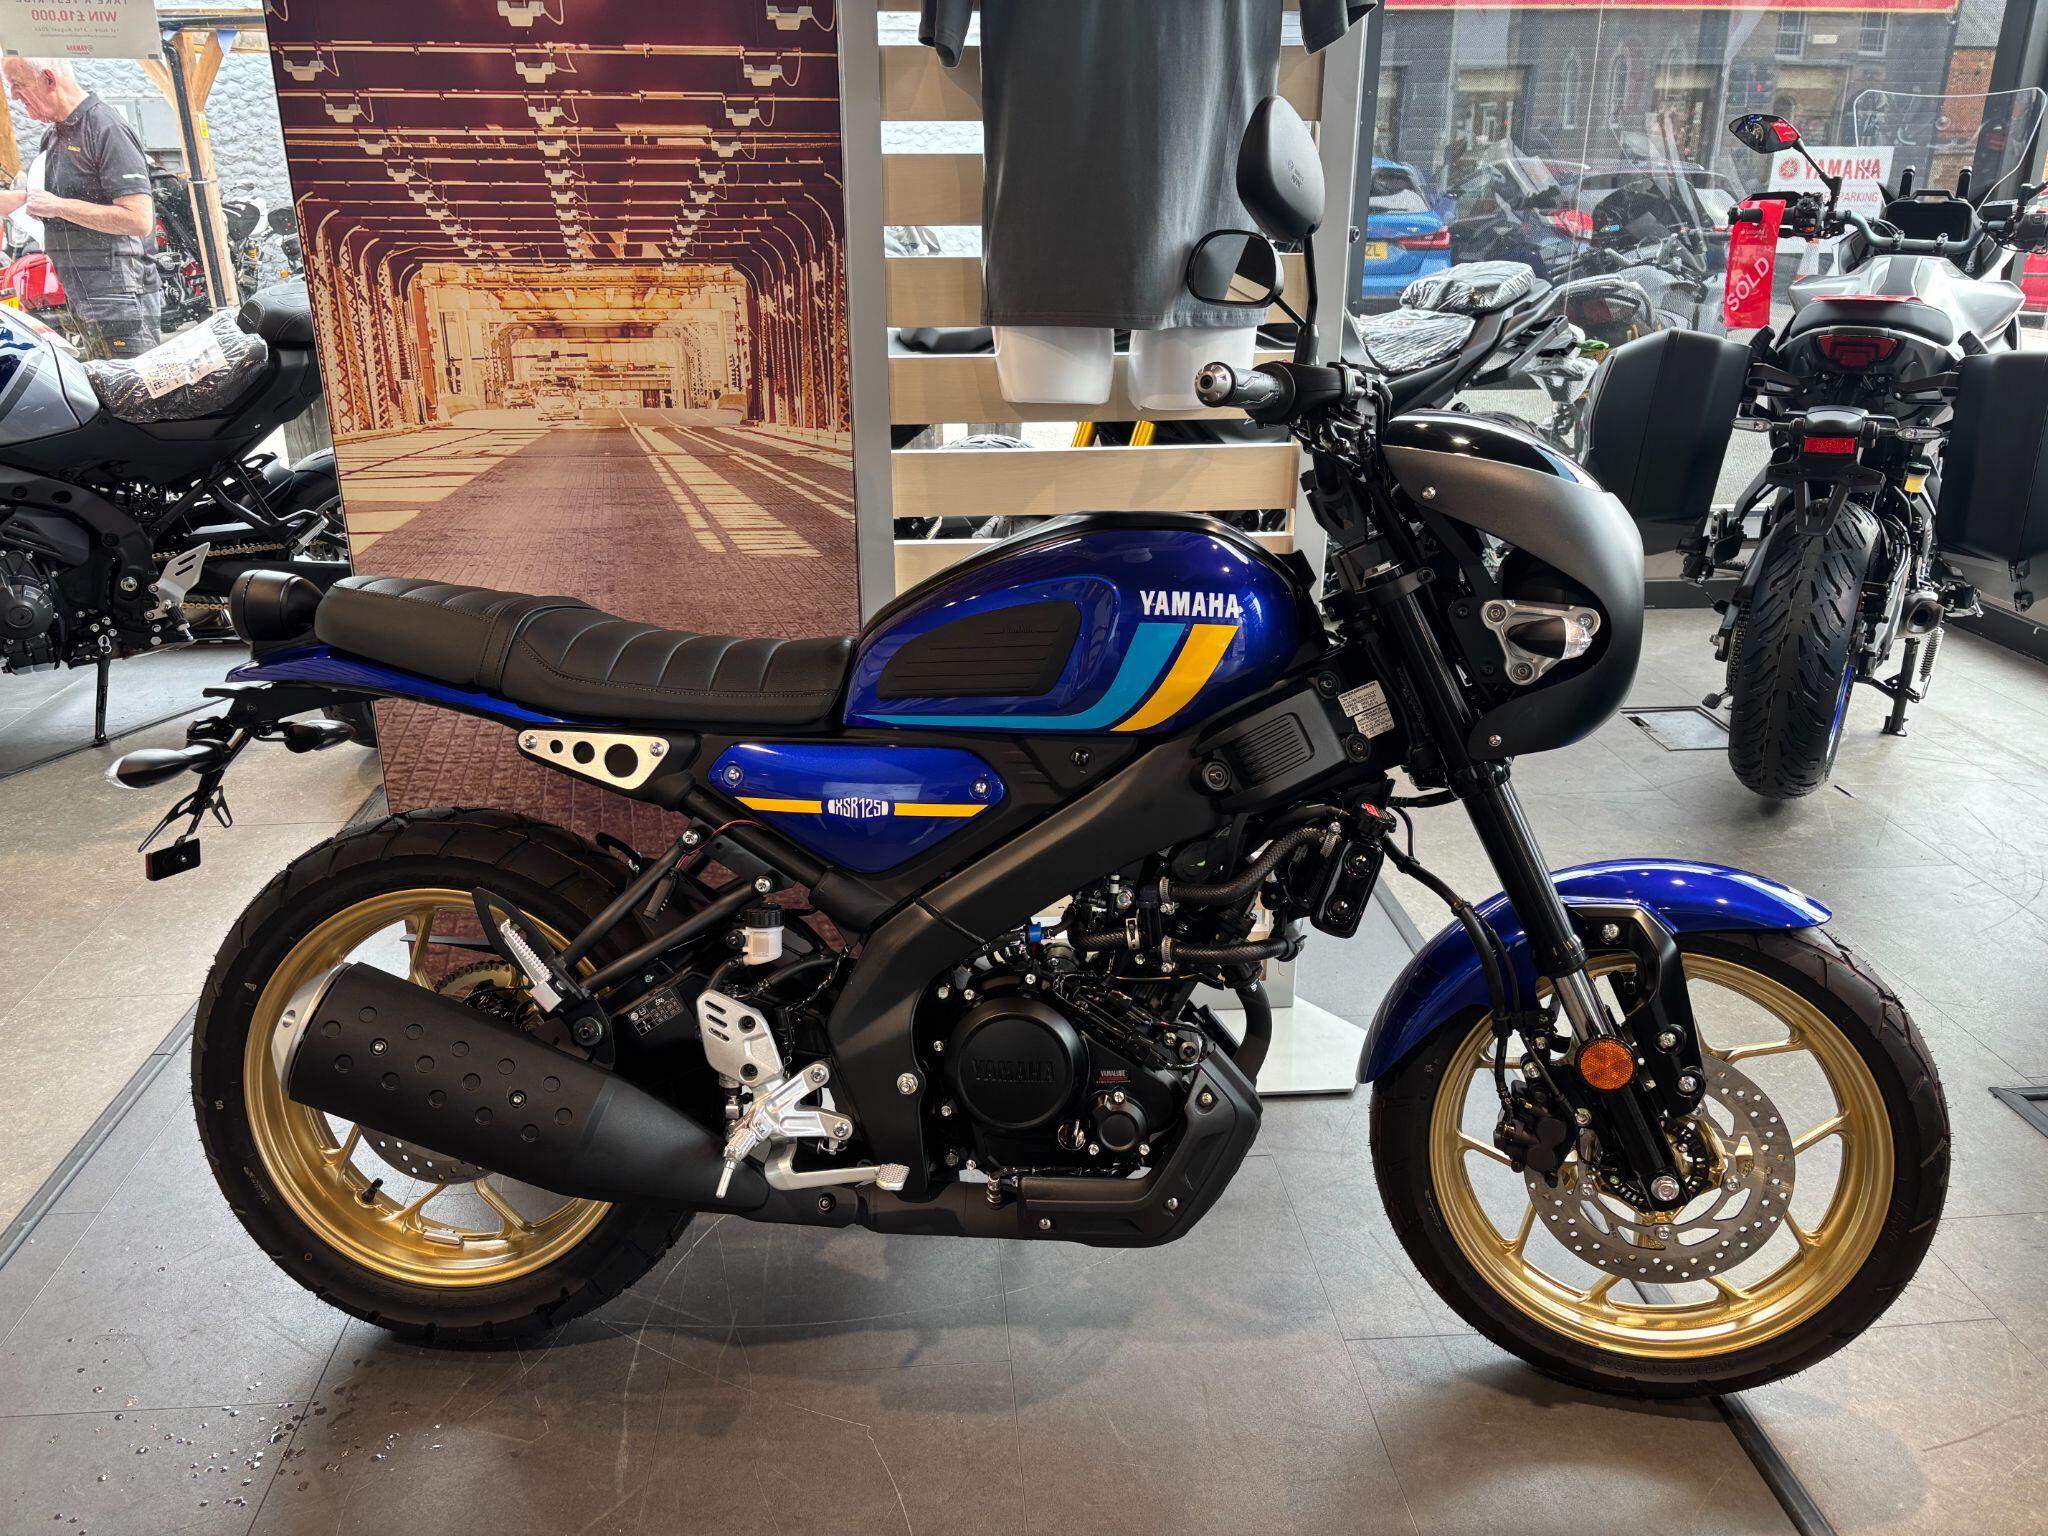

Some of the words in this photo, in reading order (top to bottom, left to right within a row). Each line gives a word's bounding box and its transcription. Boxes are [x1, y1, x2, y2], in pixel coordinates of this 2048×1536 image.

[1804, 159, 1881, 179] YAMAHA
[1838, 191, 1878, 202] PARKING
[1726, 257, 1770, 312] SOLD
[1140, 590, 1240, 618] YAMAHA
[835, 797, 880, 818] XSR125
[970, 1059, 1057, 1082] YAMAHA
